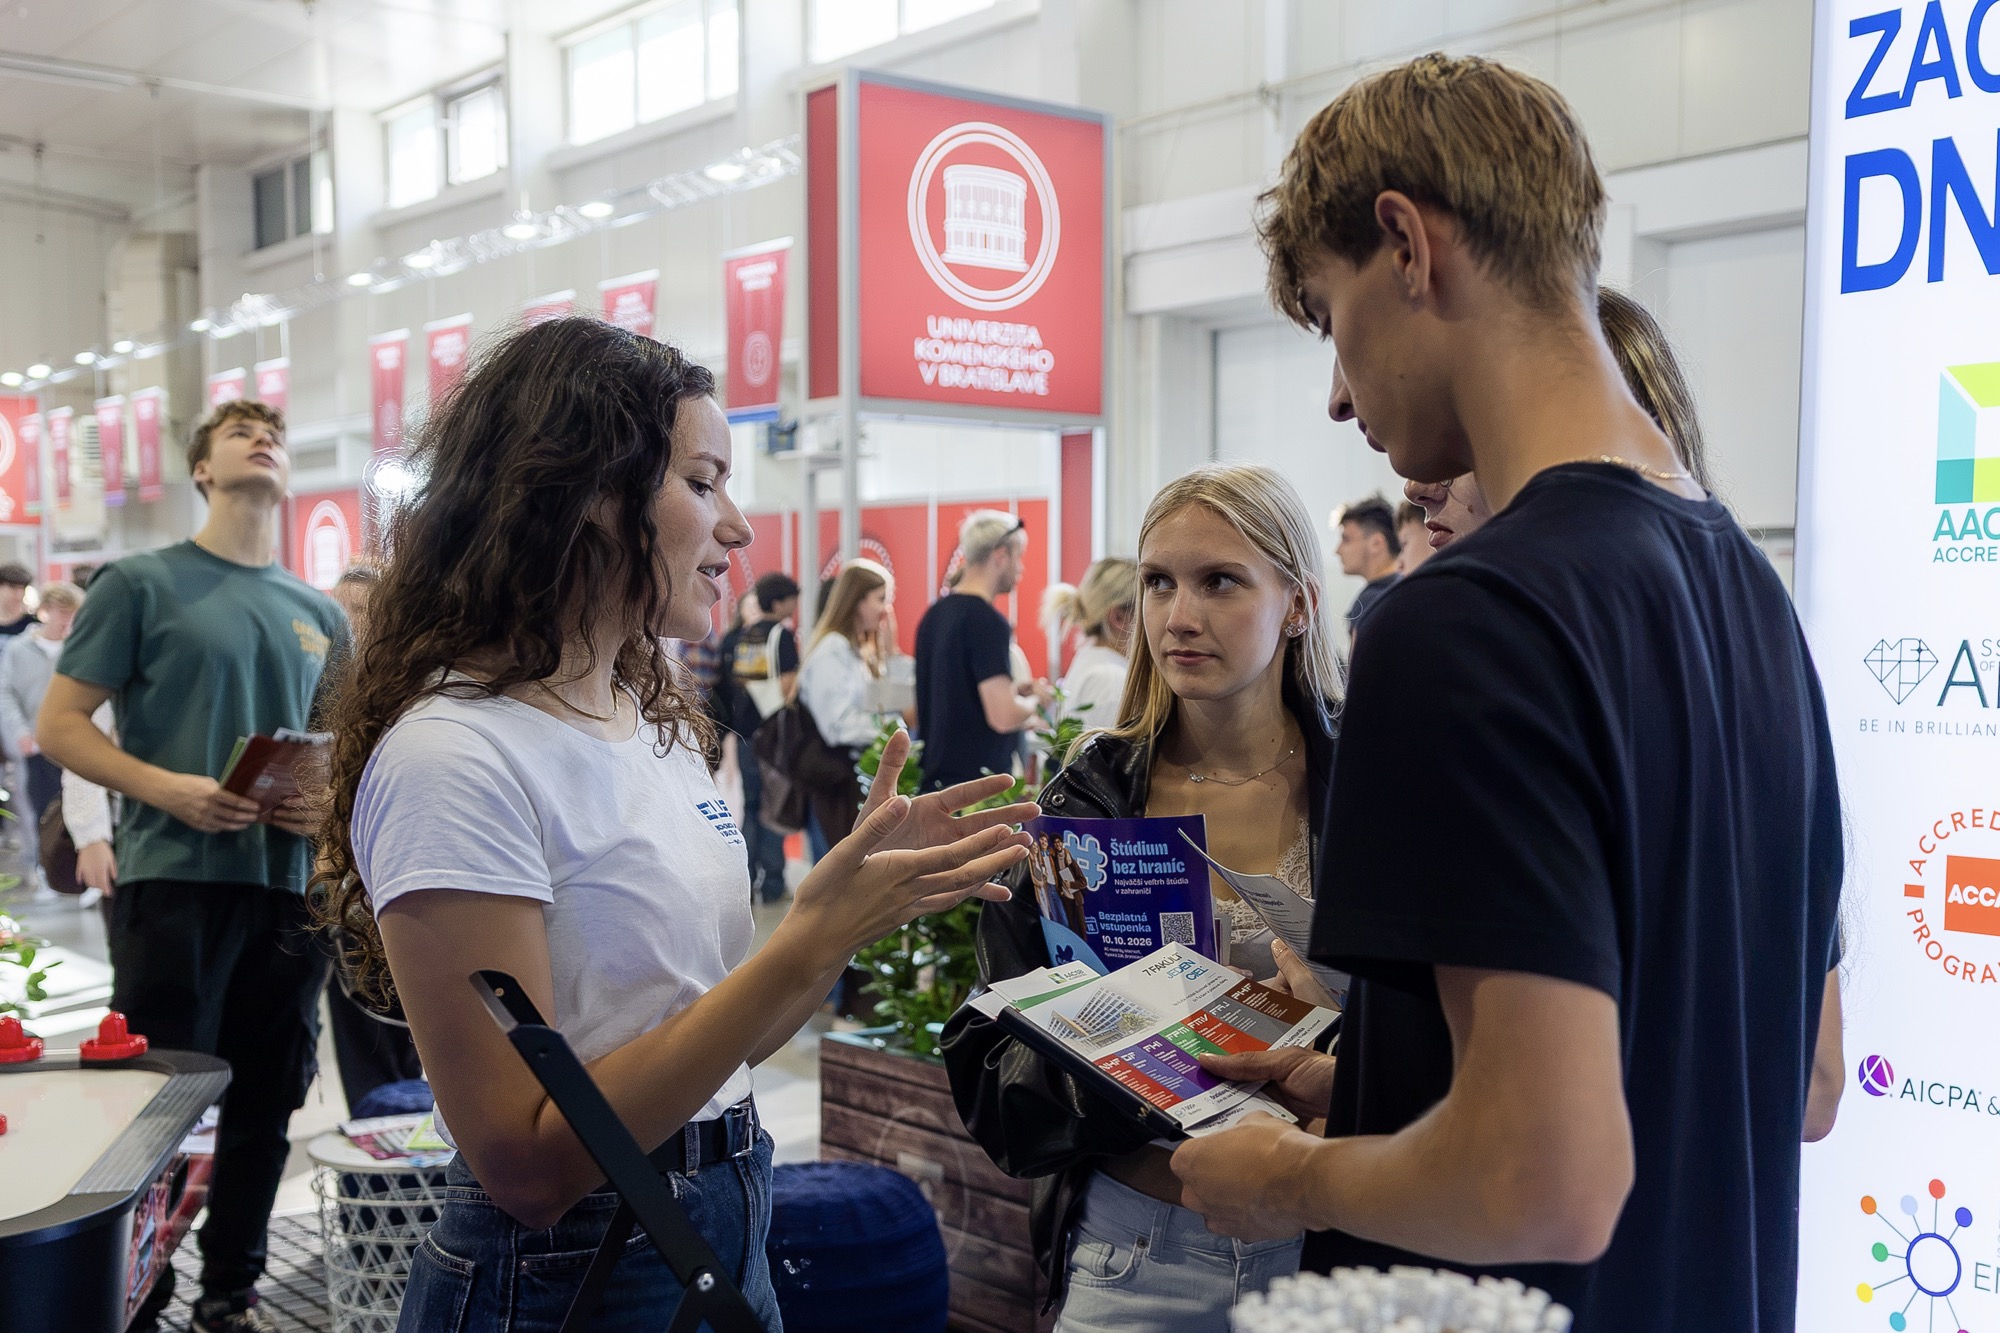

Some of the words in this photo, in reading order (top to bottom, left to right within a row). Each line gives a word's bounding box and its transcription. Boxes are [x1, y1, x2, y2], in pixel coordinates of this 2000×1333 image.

[926, 314, 1044, 349] UNIVERZITA
[918, 361, 938, 386] V
[938, 362, 1050, 396] BRATISLAVE
[1932, 546, 1998, 563] ACCRE
[1979, 660, 1996, 671] OF
[1859, 718, 1879, 732] BE
[1888, 719, 1905, 733] IN
[1915, 720, 1997, 737] BRILLIAN
[1110, 838, 1169, 856] Štúdium
[1112, 859, 1137, 875] bez
[1138, 857, 1186, 875] hraníc
[1098, 911, 1148, 923] Bezplatná
[1100, 922, 1152, 933] vstupenka
[1906, 908, 2000, 984] PROGRA
[1141, 968, 1152, 977] 7
[1166, 959, 1196, 979] JEDEN
[1899, 1078, 1981, 1113] AICPA
